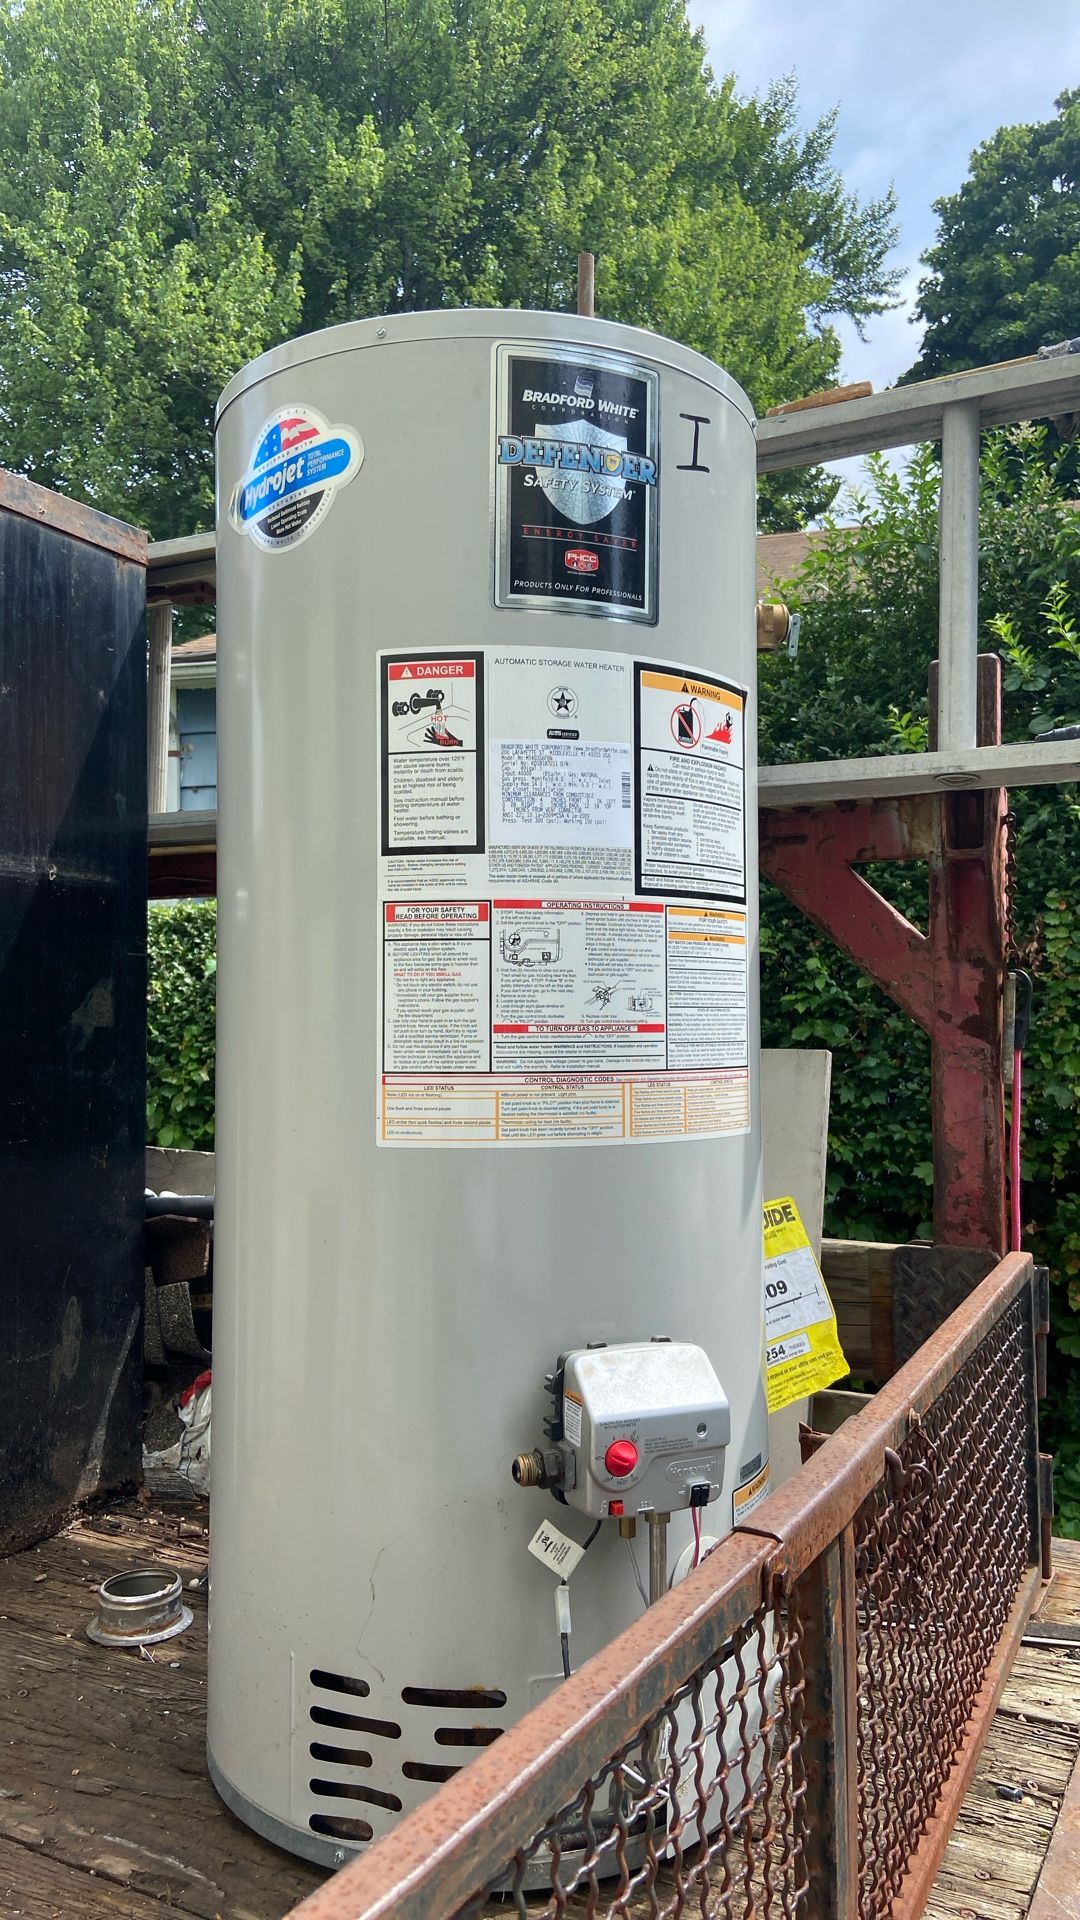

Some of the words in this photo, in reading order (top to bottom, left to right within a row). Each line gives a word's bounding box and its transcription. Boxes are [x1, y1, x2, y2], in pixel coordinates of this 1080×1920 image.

[522, 389, 595, 410] BRADFORD
[598, 400, 637, 419] WHITE
[531, 404, 629, 425] CORPORATION
[258, 450, 290, 473] EQUIPPED
[295, 439, 314, 451] WITH
[307, 449, 322, 460] TOTAL
[307, 449, 345, 468] PERFORMANCE
[498, 435, 657, 487] DEFENDER
[307, 463, 327, 477] SYSTEM
[244, 456, 305, 511] Hydrojet
[523, 474, 579, 492] SAFETY
[583, 480, 633, 501] SYSTEM
[268, 489, 308, 512] FEATURING
[523, 527, 583, 541] ENERGY
[594, 534, 638, 549] SAVER
[567, 553, 598, 563] PHCC
[513, 580, 553, 590] PRODUCTS
[554, 582, 574, 592] ONLY
[575, 584, 590, 593] FOR
[591, 586, 643, 602] PROFESSIONALS
[417, 665, 463, 675] DANGER
[538, 659, 572, 668] STORAGE
[574, 662, 598, 670] WATER
[598, 663, 625, 672] HEATER
[691, 685, 721, 701] WARNING
[765, 1280, 788, 1299] 09
